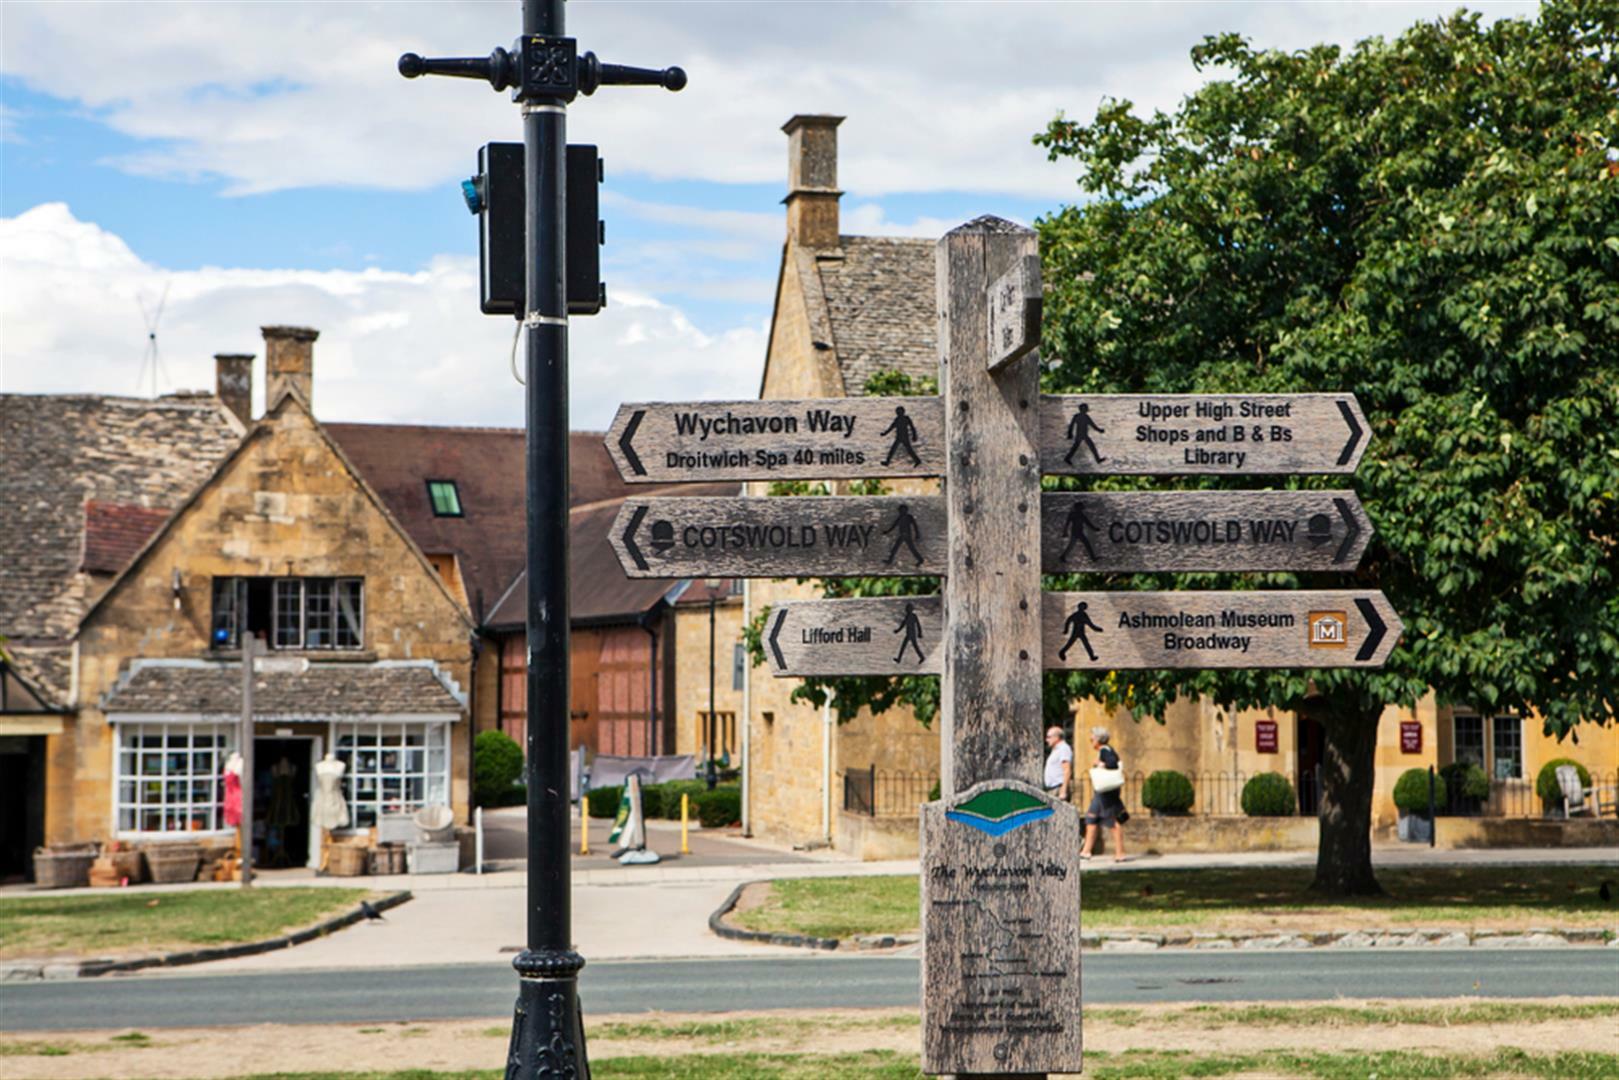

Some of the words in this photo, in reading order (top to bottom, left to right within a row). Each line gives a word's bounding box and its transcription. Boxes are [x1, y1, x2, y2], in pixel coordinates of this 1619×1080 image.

[1138, 402, 1190, 421] Upper
[1196, 402, 1233, 421] High
[1239, 401, 1291, 418] Street
[674, 412, 798, 440] Wychavon
[806, 410, 856, 438] Way
[1136, 425, 1190, 446] Shops
[1195, 425, 1226, 442] and
[1233, 425, 1245, 442] B
[1251, 425, 1264, 442] &
[1270, 425, 1293, 442] Bs
[666, 450, 749, 468] Droitwich
[755, 449, 788, 470] Spa
[793, 449, 814, 466] 40
[819, 449, 866, 466] miles
[1184, 448, 1246, 469] Library
[683, 524, 817, 549] COTSWOLD
[824, 524, 874, 551] WAY
[1108, 520, 1242, 544] COTSWOLD
[1249, 519, 1299, 543] WAY
[1118, 611, 1215, 629] Ashmolean
[1220, 610, 1295, 628] Museum
[802, 627, 844, 644] Lifford
[847, 626, 871, 643] Hall
[1164, 633, 1251, 653] Broadway
